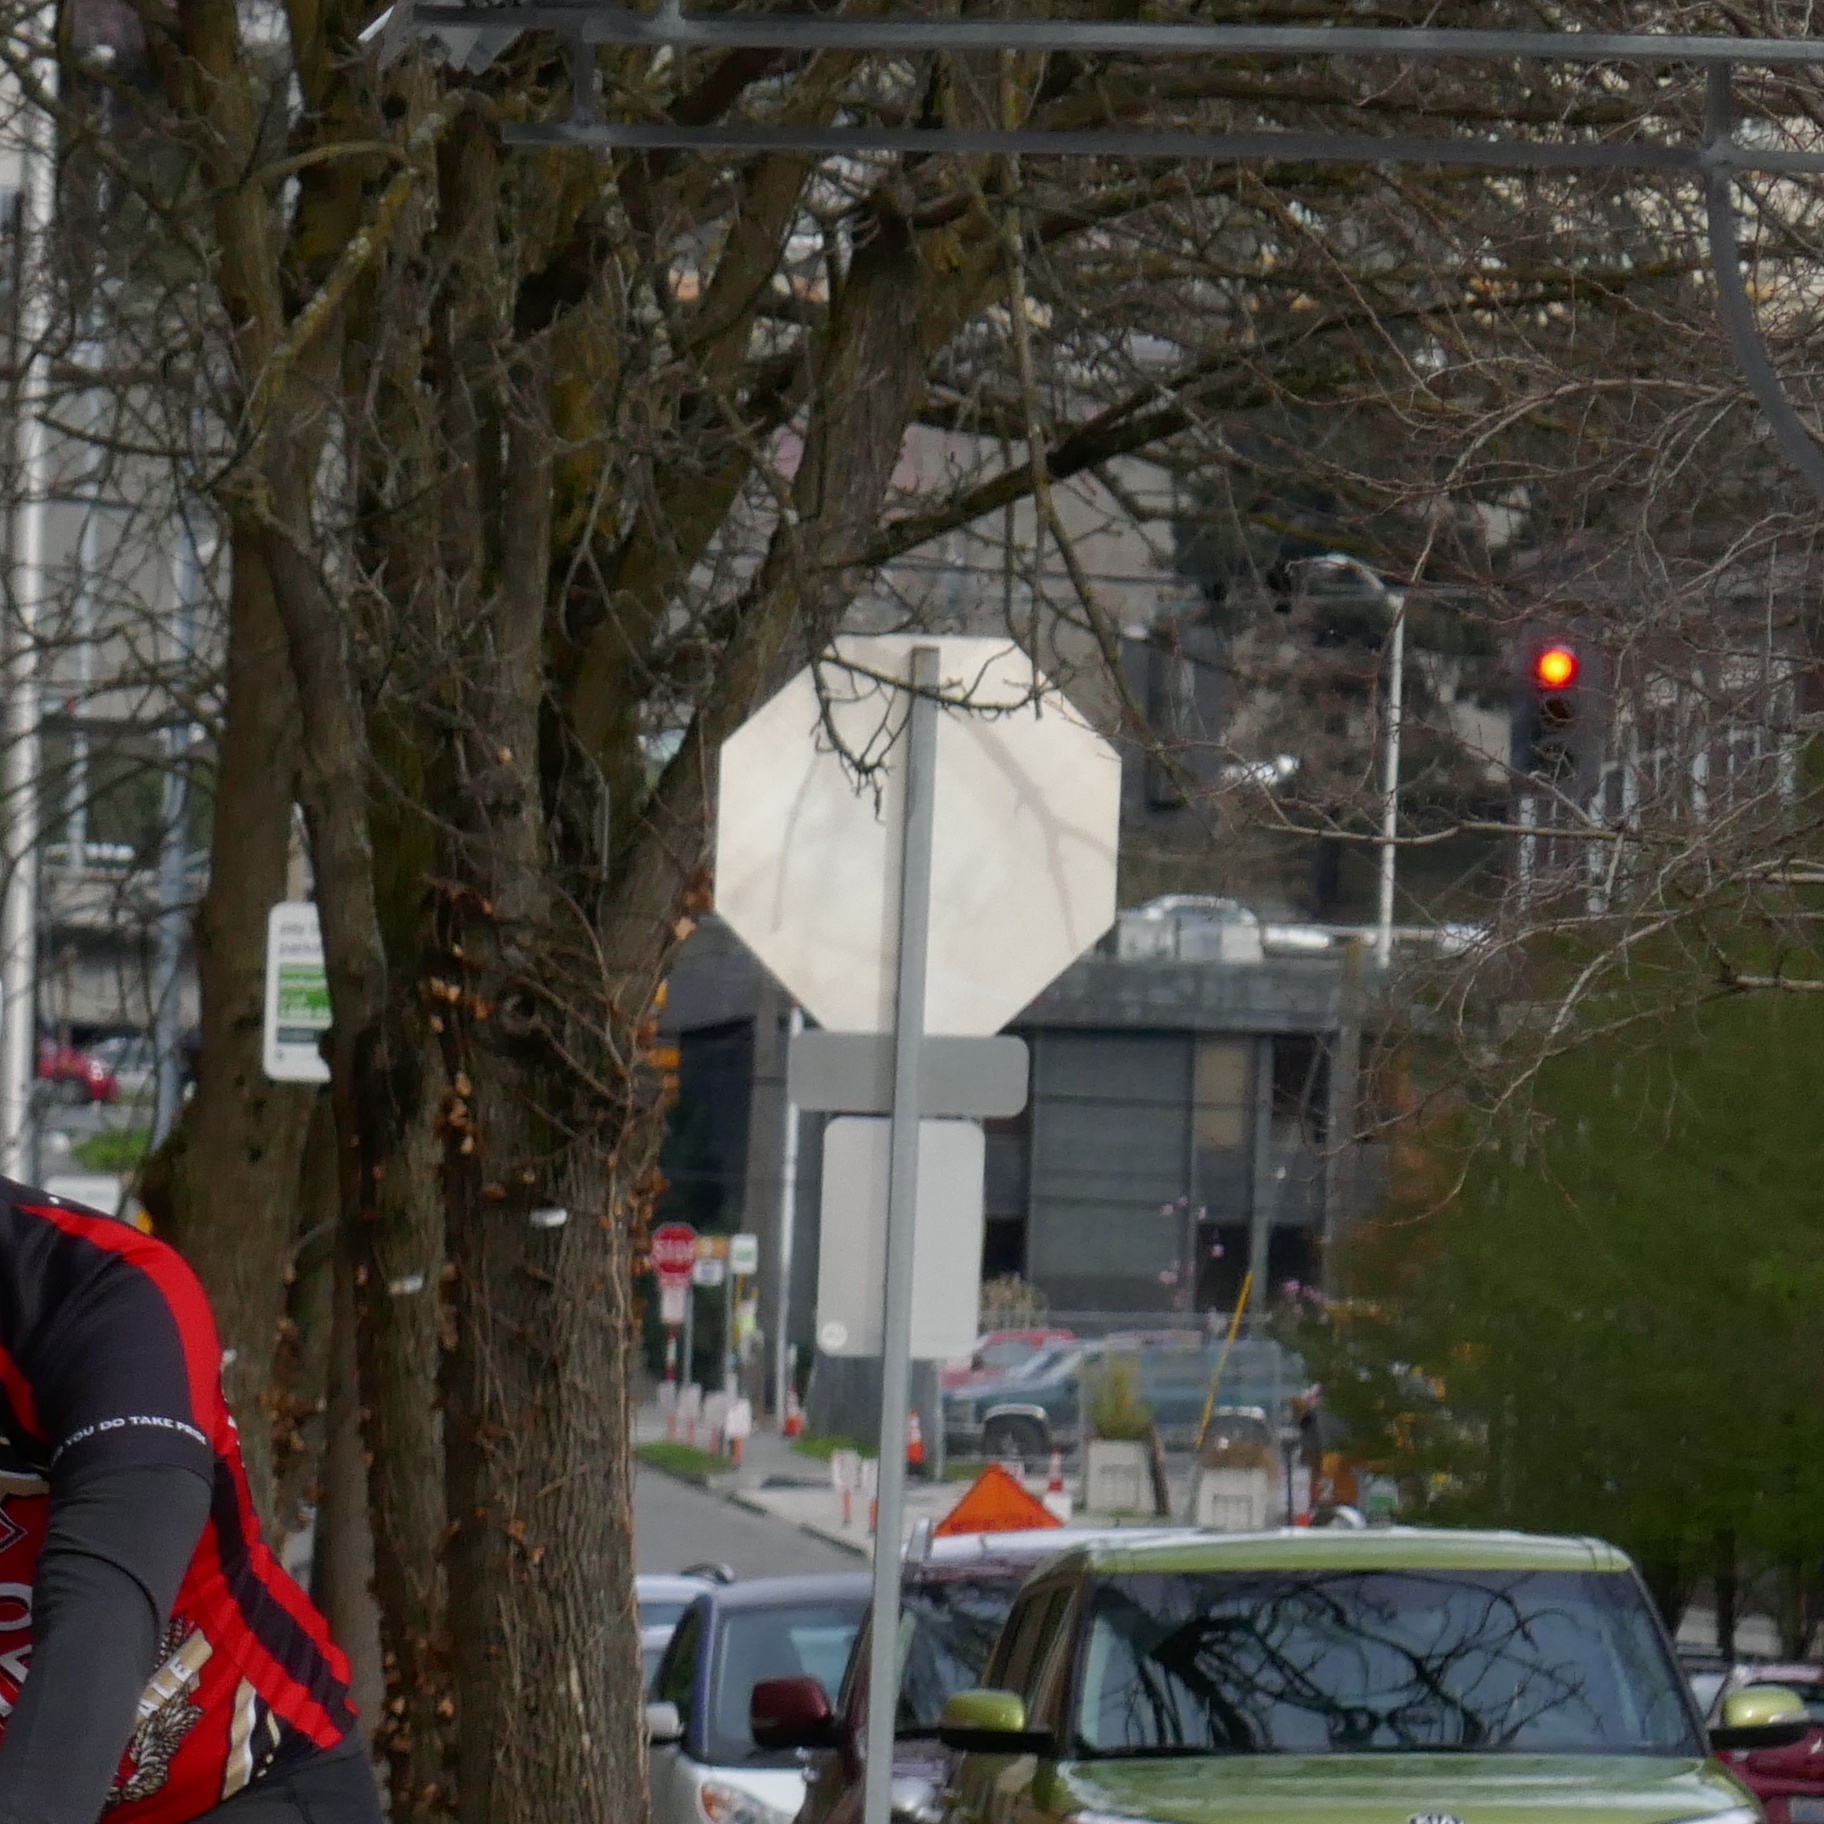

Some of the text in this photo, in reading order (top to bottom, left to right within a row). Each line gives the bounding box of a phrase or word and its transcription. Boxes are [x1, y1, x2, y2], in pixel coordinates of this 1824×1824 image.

[65, 1425, 95, 1446] YOU
[99, 1417, 126, 1431] DO
[127, 1415, 174, 1428] TAKE
